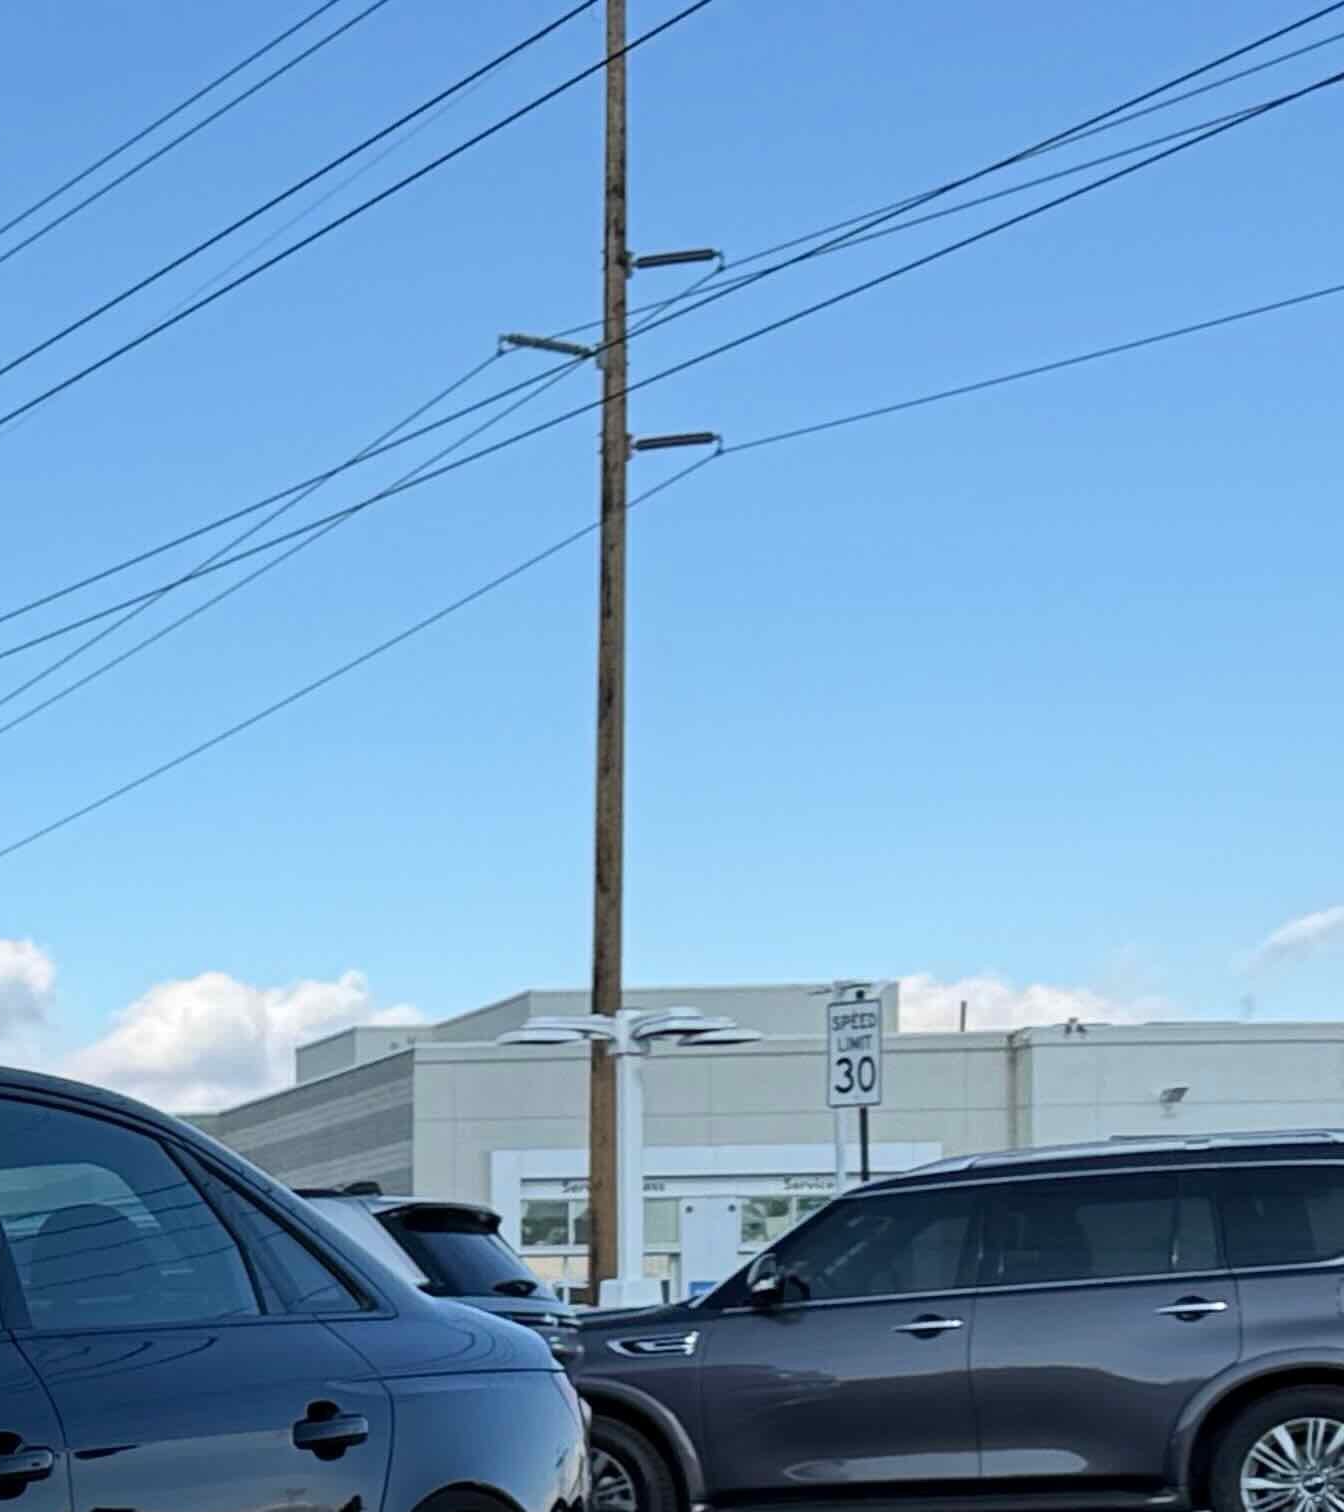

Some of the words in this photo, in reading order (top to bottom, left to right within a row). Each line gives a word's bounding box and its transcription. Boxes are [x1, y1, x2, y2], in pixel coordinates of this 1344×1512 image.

[832, 1012, 876, 1031] SPEED
[837, 1034, 872, 1053] LIMIT
[834, 1056, 876, 1093] 30
